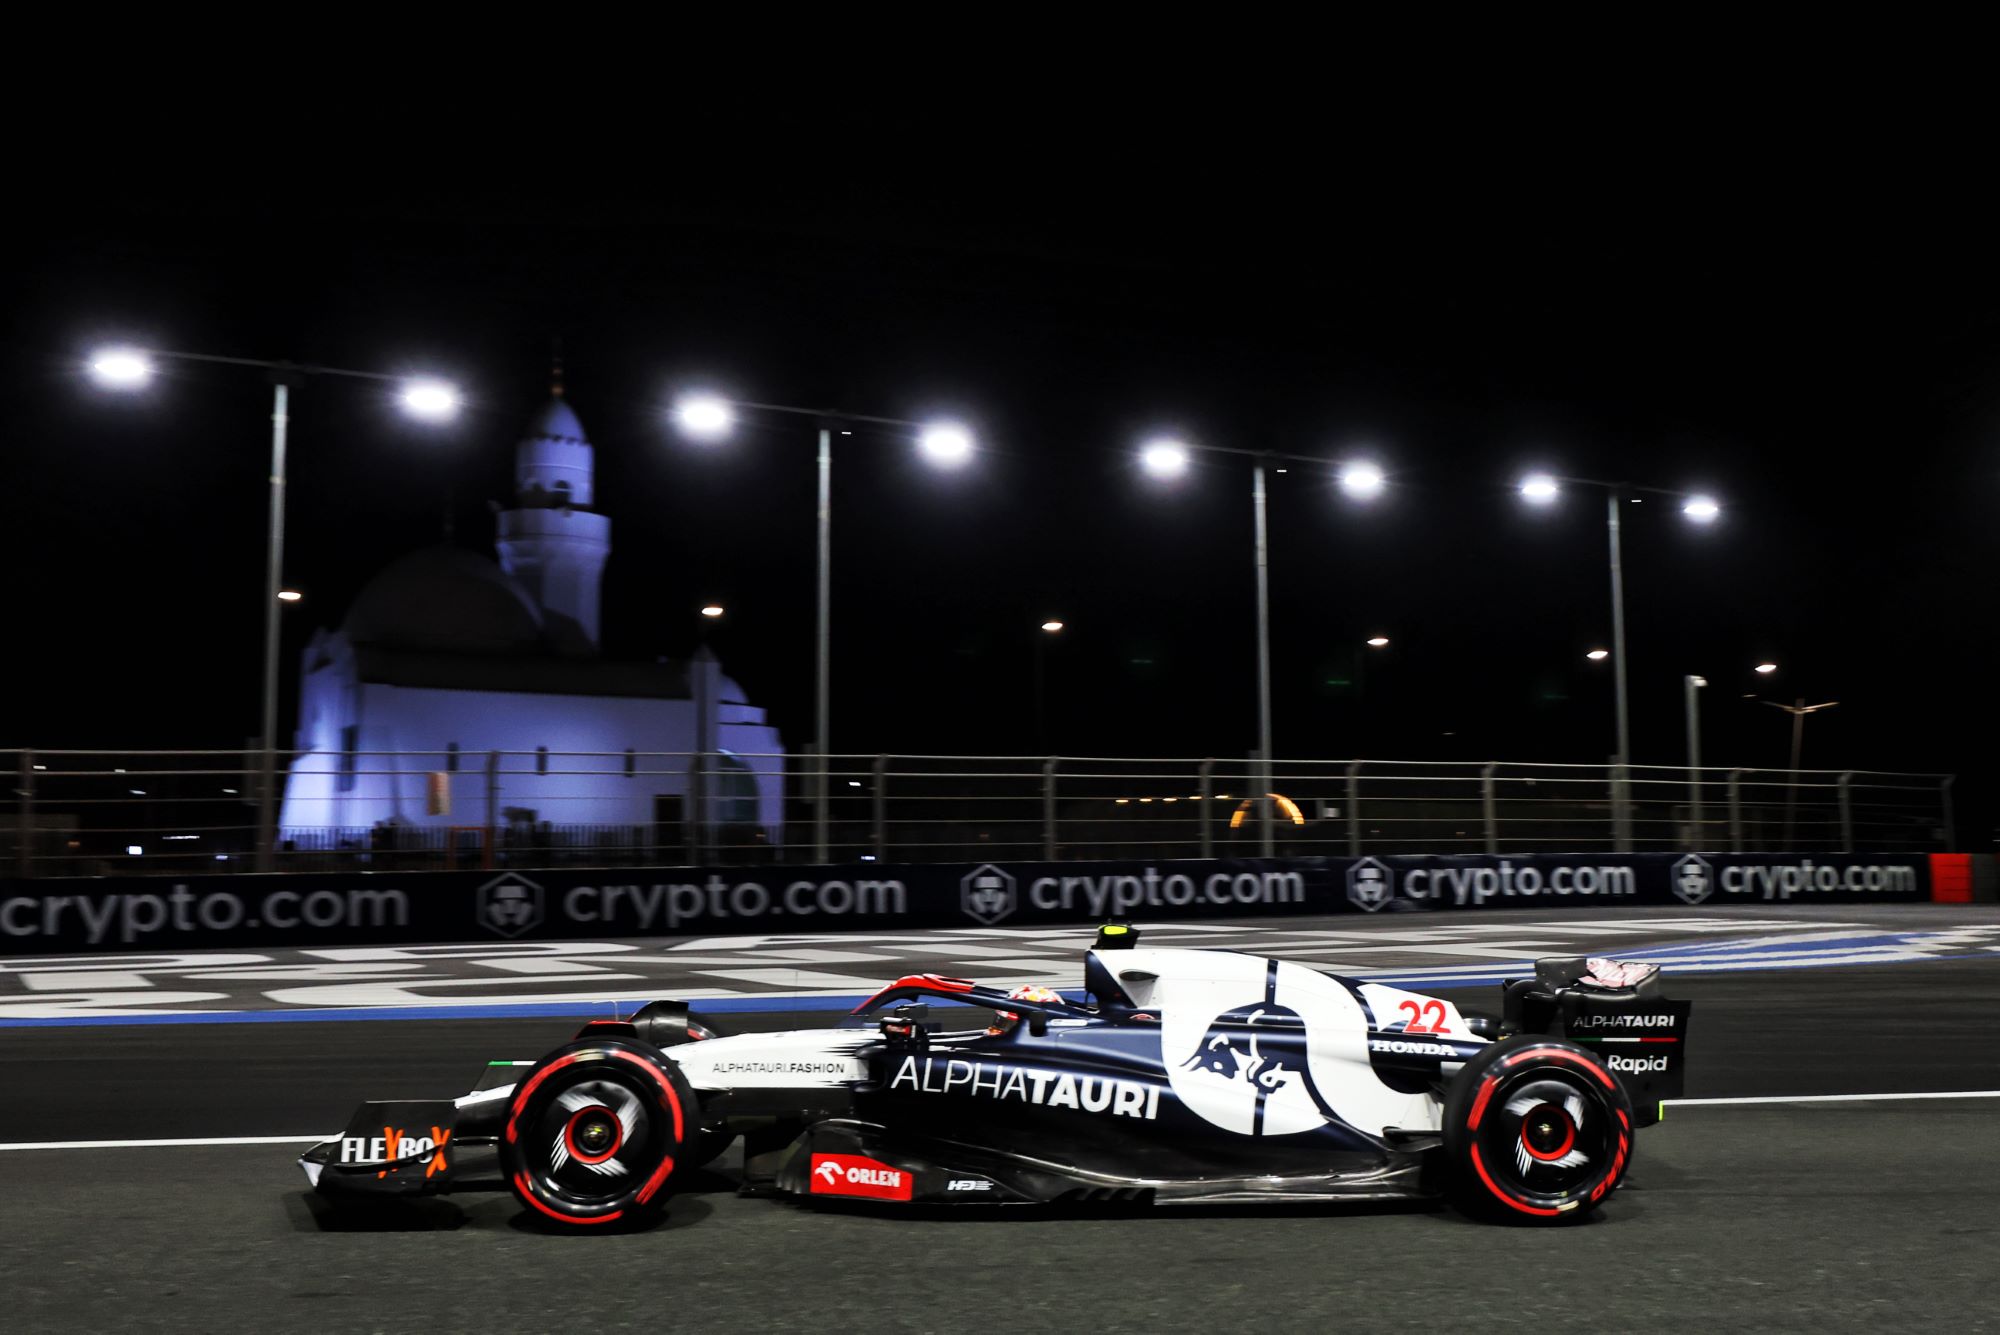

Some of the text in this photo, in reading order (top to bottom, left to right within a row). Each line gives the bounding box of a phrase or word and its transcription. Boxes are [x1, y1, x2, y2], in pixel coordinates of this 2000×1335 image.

[1029, 866, 1305, 916] crypto.com
[1404, 861, 1635, 905] crypto.com
[1720, 860, 1916, 898] crypto.com
[0, 884, 408, 944] crypto.com
[564, 875, 906, 928] crypto.com
[1398, 1000, 1451, 1033] 22
[1573, 1014, 1675, 1028] ALPHATAURI
[1371, 1040, 1458, 1057] HONDA
[1607, 1054, 1668, 1075] Rapid
[712, 1062, 845, 1074] ALPHATAURI.FASHION
[890, 1055, 1160, 1121] ALPHATAURI
[846, 1167, 900, 1188] ORLEN
